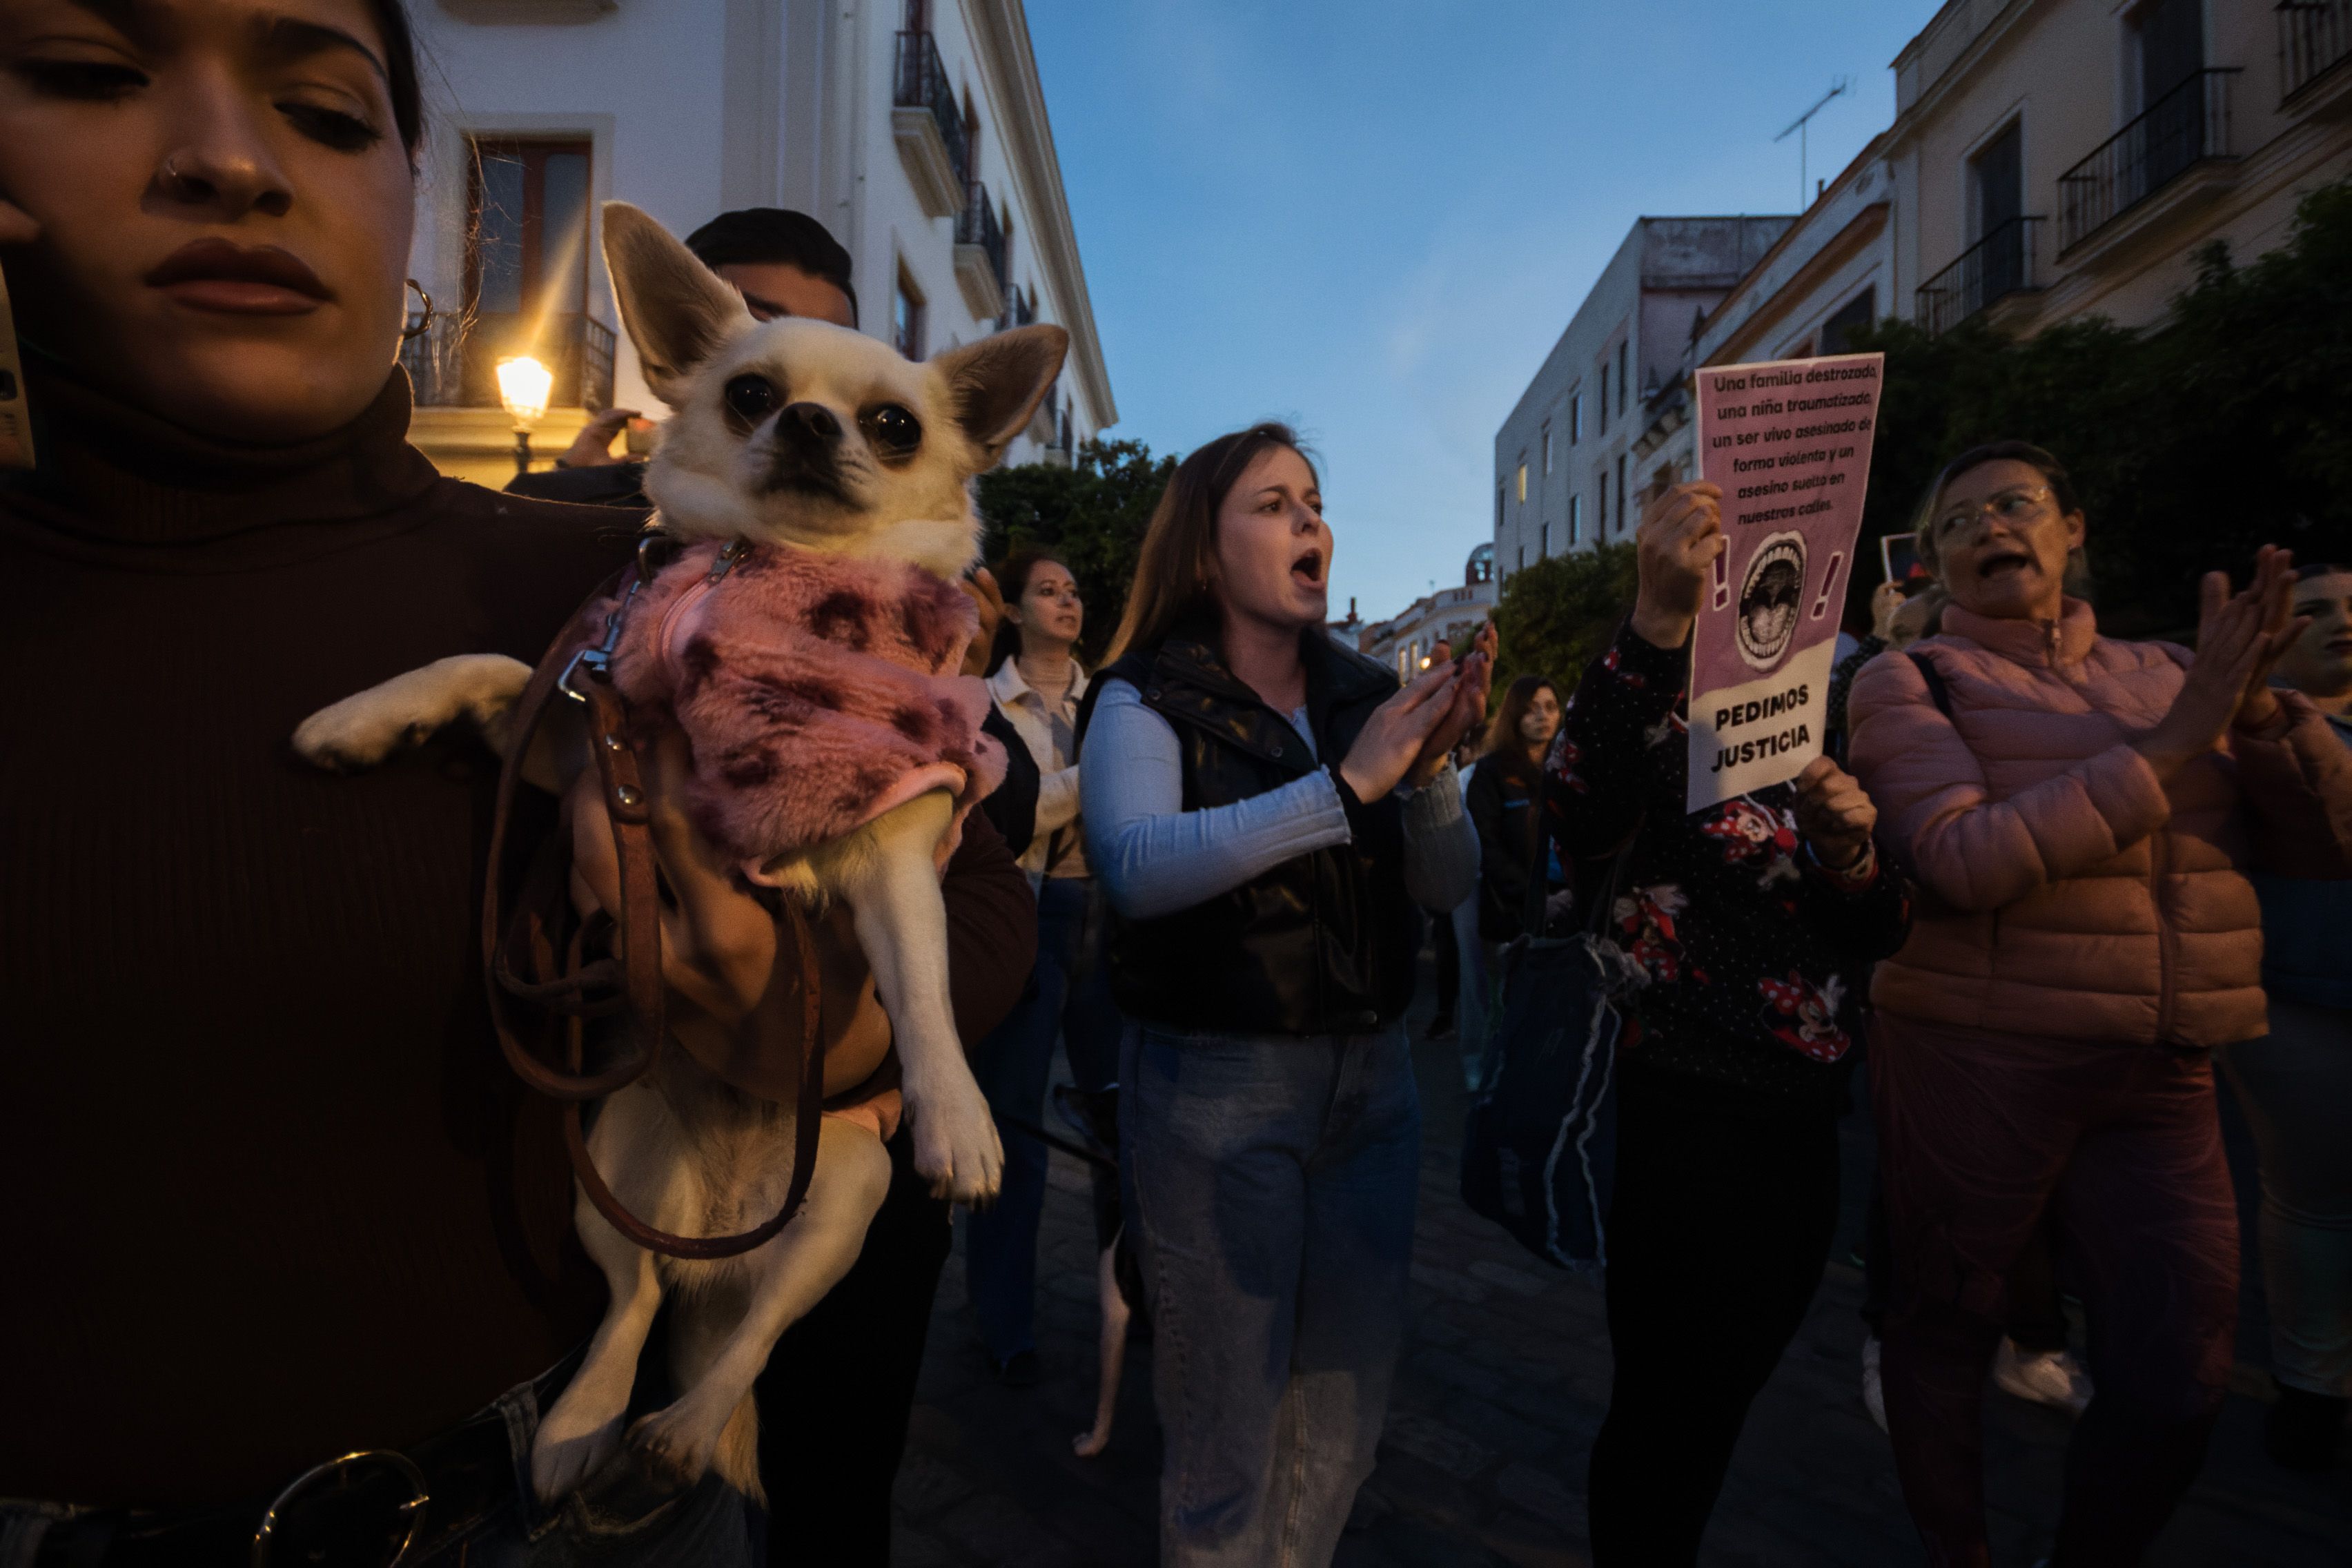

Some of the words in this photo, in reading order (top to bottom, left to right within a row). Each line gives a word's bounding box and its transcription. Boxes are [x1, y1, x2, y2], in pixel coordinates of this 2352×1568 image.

[1714, 376, 1746, 392] Una
[1750, 371, 1802, 389] familia
[1717, 406, 1747, 420] una
[1752, 399, 1783, 416] niña
[1712, 435, 1732, 449] un
[1736, 431, 1760, 446] ser
[1764, 427, 1792, 442] vivo
[1796, 418, 1855, 439] asesinado
[1859, 415, 1872, 431] de
[1733, 458, 1774, 473] forma
[1779, 449, 1826, 467] violenta
[1829, 449, 1837, 463] y
[1839, 447, 1854, 459] un
[1738, 480, 1789, 498] asesino
[1792, 475, 1826, 491] suelto
[1830, 473, 1845, 485] en
[1738, 506, 1795, 525] nuestras
[1716, 683, 1809, 732] PEDIMOS
[1710, 723, 1810, 773] JUSTICIA
